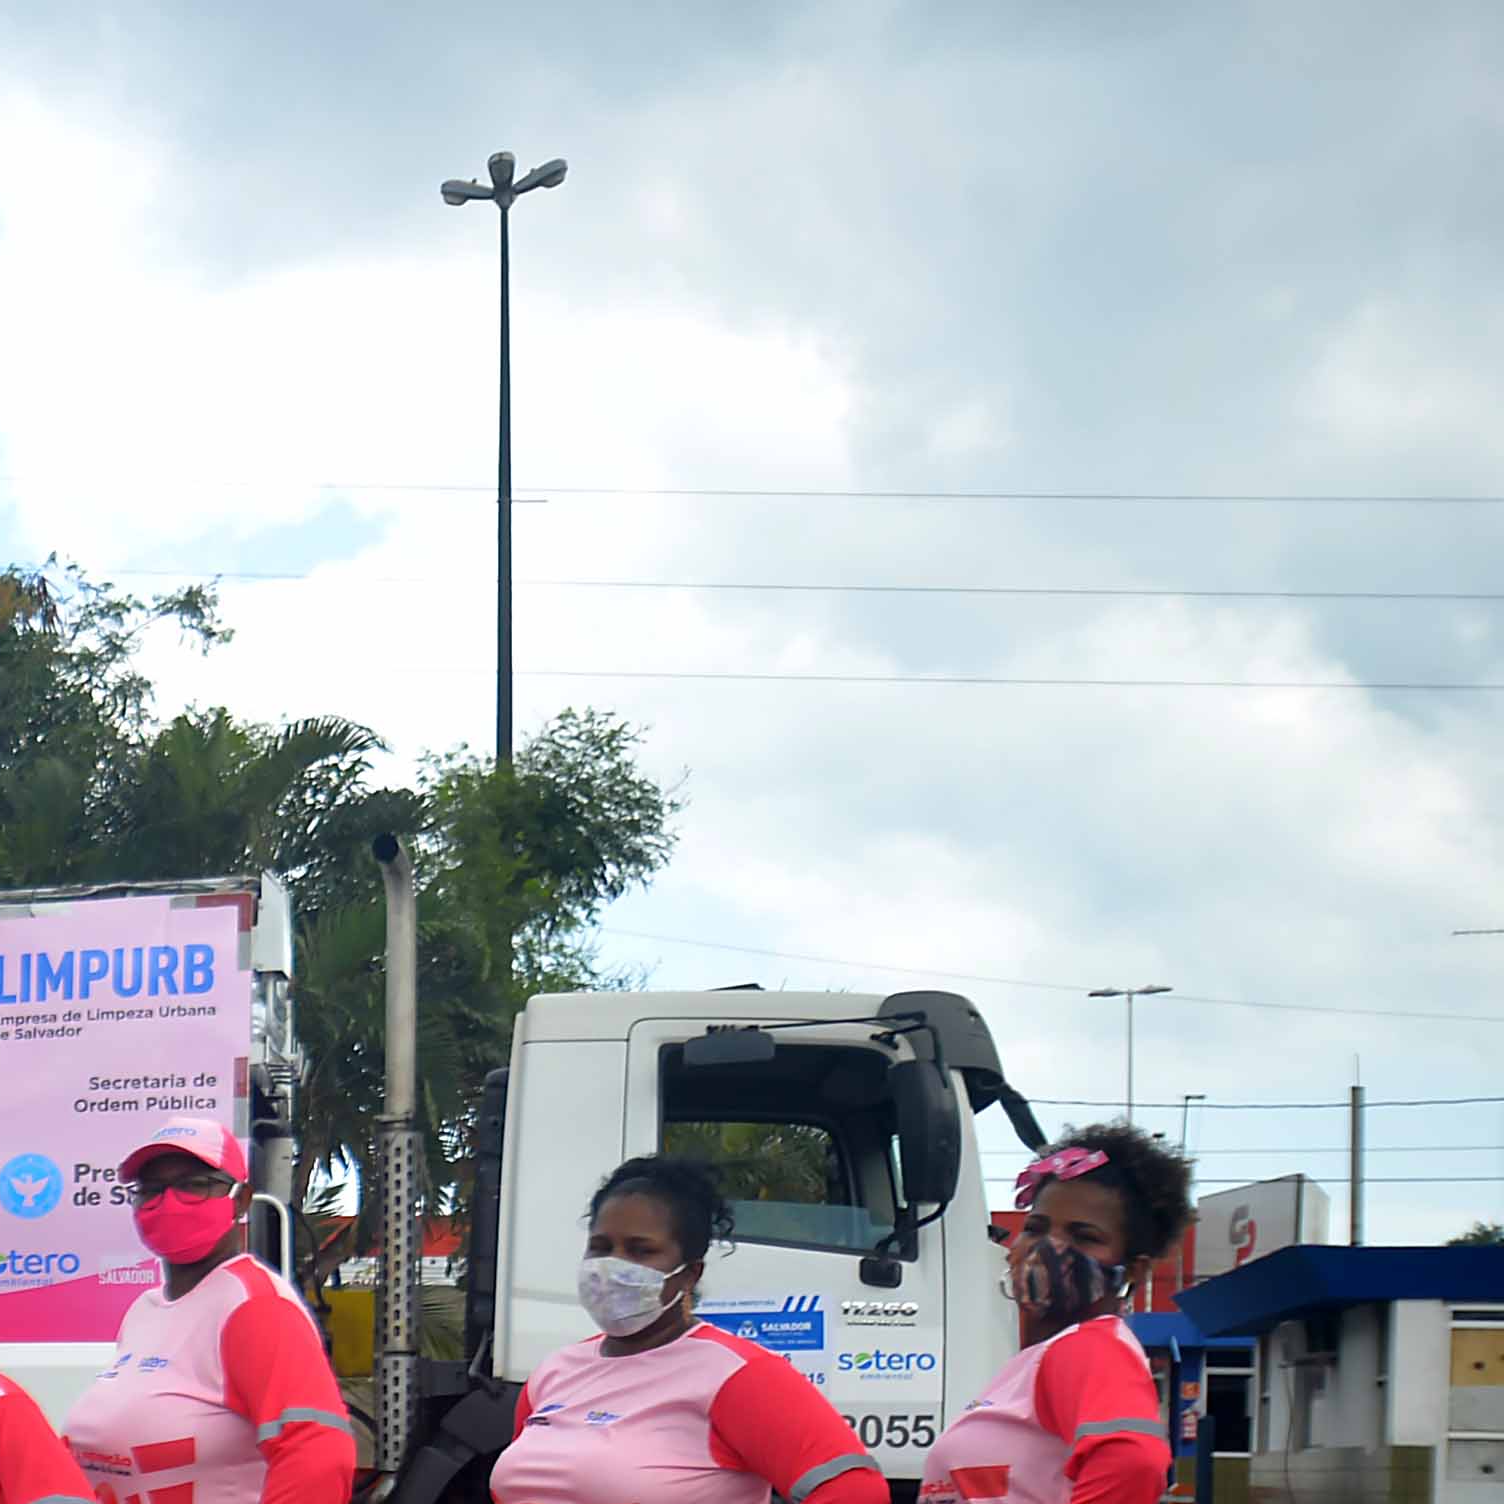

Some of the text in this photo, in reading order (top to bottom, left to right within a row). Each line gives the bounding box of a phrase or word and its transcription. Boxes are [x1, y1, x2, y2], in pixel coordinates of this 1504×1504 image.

[62, 1010, 82, 1023] de
[87, 1007, 154, 1024] Limpeza
[158, 1004, 217, 1019] Urbana
[14, 1026, 83, 1041] Salvador
[88, 1072, 217, 1090] Secretaria de
[73, 1095, 217, 1113] Ordem Pública
[73, 1163, 120, 1183] Pre
[72, 1186, 101, 1206] de
[838, 1349, 936, 1371] sotero
